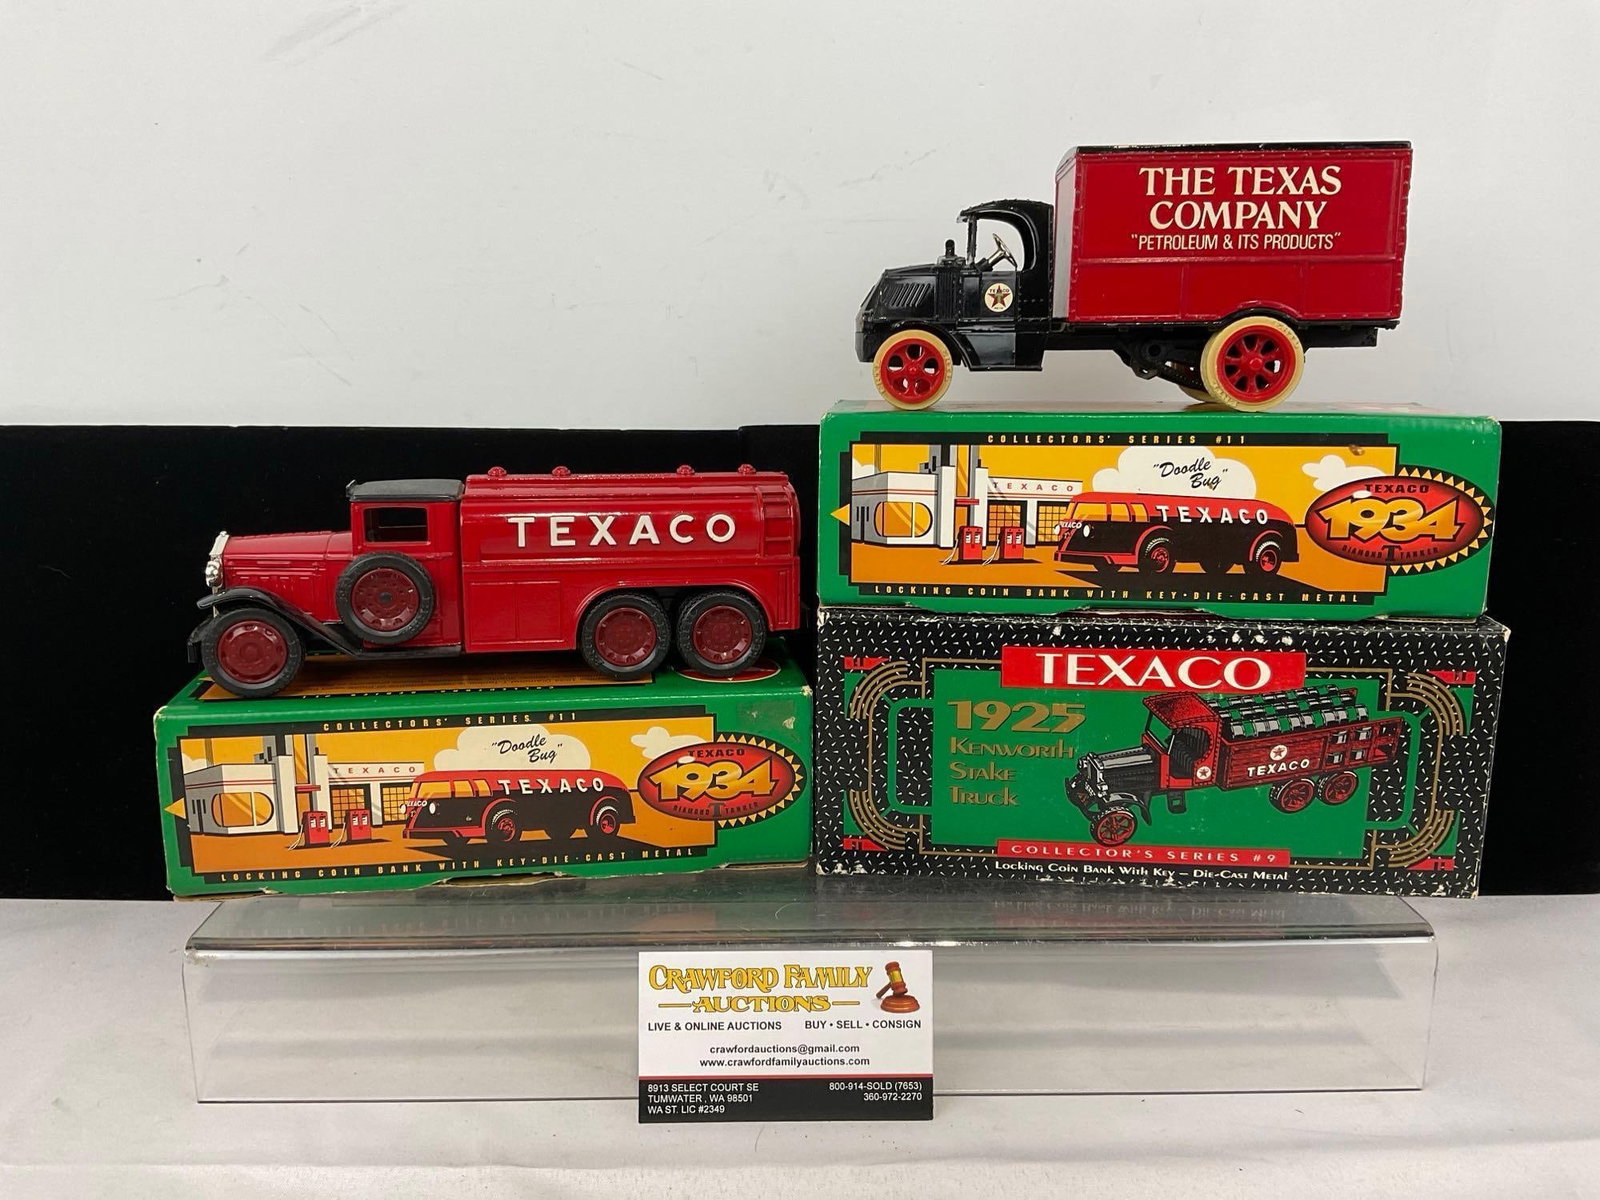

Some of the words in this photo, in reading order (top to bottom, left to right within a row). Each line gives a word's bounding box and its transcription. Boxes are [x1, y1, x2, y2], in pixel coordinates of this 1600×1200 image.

[1139, 166, 1215, 196] THE
[1226, 165, 1342, 195] TEXAS
[1150, 201, 1326, 230] COMPANY
[1131, 233, 1218, 252] "PETROLEUM
[1223, 234, 1233, 250] &
[1238, 234, 1260, 250] ITS
[1264, 232, 1341, 250] PRODUCTS"
[988, 435, 1111, 444] COLLECTORS'
[1129, 435, 1196, 444] SERIES
[1216, 435, 1246, 444] #11
[992, 482, 1074, 492] TEXACO
[1364, 484, 1430, 494] TEXACO
[1156, 505, 1268, 524] TEXACO
[1317, 496, 1464, 541] 1934
[508, 514, 736, 548] TEXACO
[1381, 545, 1402, 563] T
[1401, 548, 1439, 558] TANKER
[876, 585, 951, 595] LOCKING
[968, 587, 1009, 596] COIN
[1026, 588, 1070, 598] BANK
[1087, 590, 1129, 598] WITH
[1302, 593, 1358, 602] METAL
[1036, 653, 1271, 690] TEXACO
[324, 718, 447, 732] COLLECTORS'
[466, 714, 530, 725] SERIES
[549, 712, 576, 720] #11
[948, 700, 1086, 733] 1925
[688, 748, 745, 759] TEXACO
[332, 766, 416, 774] TEXACO
[1247, 759, 1310, 776] TEXACO
[498, 778, 604, 795] TEXACO
[650, 758, 776, 800] 1934
[1011, 846, 1152, 858] COLLECTOR'S
[1168, 852, 1239, 862] SERIES
[222, 870, 301, 882] LOCKING
[318, 868, 360, 877] COIN
[378, 864, 422, 874] BANK
[440, 860, 480, 870] WITH
[642, 849, 693, 858] METAL
[648, 965, 778, 992] CRAWFORD
[784, 964, 872, 988] FAMILY
[692, 996, 831, 1013] AUCTIONS
[648, 1022, 672, 1032] LIVE
[674, 1022, 682, 1032] &
[684, 1022, 724, 1031] ONLINE
[727, 1022, 782, 1030] AUCTIONS
[805, 1020, 826, 1029] BUY
[836, 1020, 862, 1029] SELL
[872, 1020, 922, 1029] CONSIGN
[710, 1044, 860, 1055] crawfordauctions@gmail.com
[700, 1056, 870, 1068] www.crawfordfamilyauctions.com
[648, 1084, 668, 1092] 8913
[672, 1084, 708, 1092] SELECT
[711, 1083, 744, 1092] COURT
[746, 1083, 759, 1092] SE
[829, 1082, 892, 1091] 800-914-SOLD
[894, 1082, 922, 1092] (7653)
[710, 1094, 724, 1103] WA
[727, 1094, 753, 1102] 98501
[864, 1092, 922, 1102] 360-972-2270
[648, 1106, 663, 1114] WA
[665, 1106, 678, 1114] ST.
[681, 1106, 696, 1114] LIC
[698, 1105, 725, 1114] #2349
